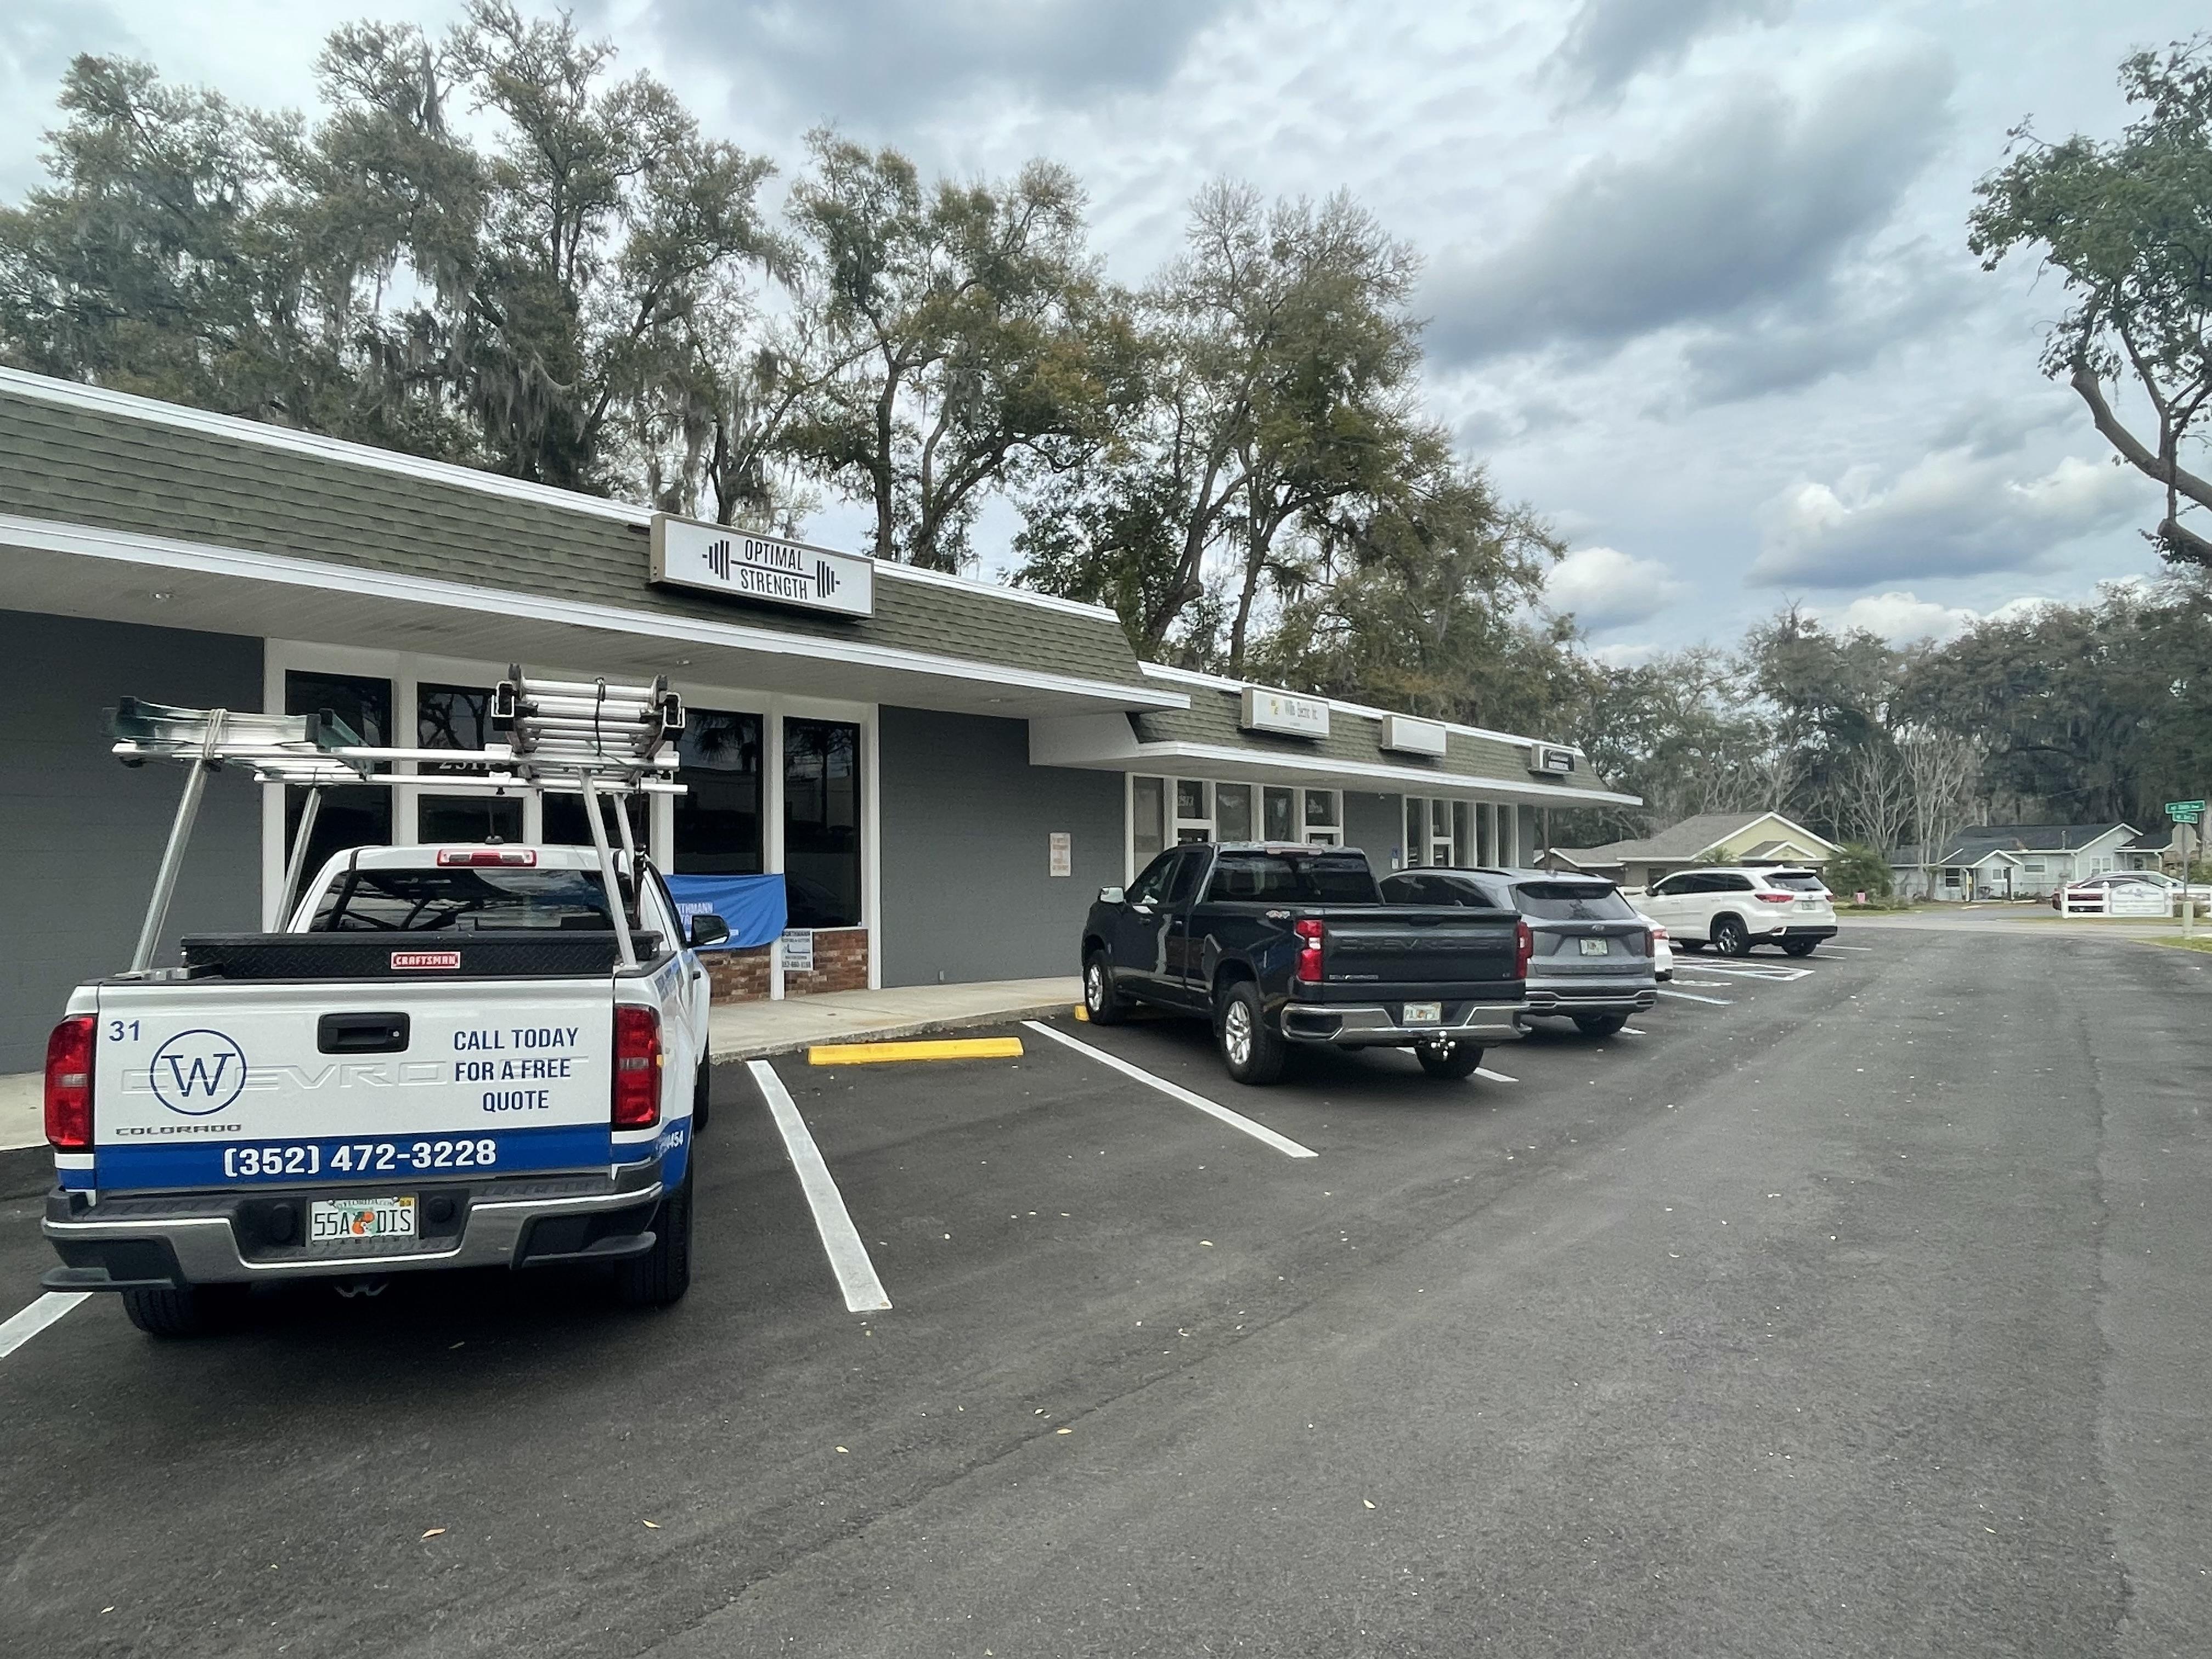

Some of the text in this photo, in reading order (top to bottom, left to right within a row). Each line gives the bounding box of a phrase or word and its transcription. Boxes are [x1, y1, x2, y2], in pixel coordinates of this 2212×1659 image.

[745, 539, 803, 571] OPTIMAL
[741, 568, 808, 600] STRENGTH
[396, 956, 455, 965] CRAFTSMAN
[109, 1019, 140, 1041] 31
[454, 1027, 579, 1051] CALL TODAY
[160, 1052, 236, 1097] W
[455, 1058, 571, 1082] FOR A FREE
[483, 1090, 549, 1113] QUOTE
[116, 1124, 241, 1136] COLORADO
[330, 1139, 496, 1172] 472-3228
[314, 1209, 411, 1237] 55A DIS
